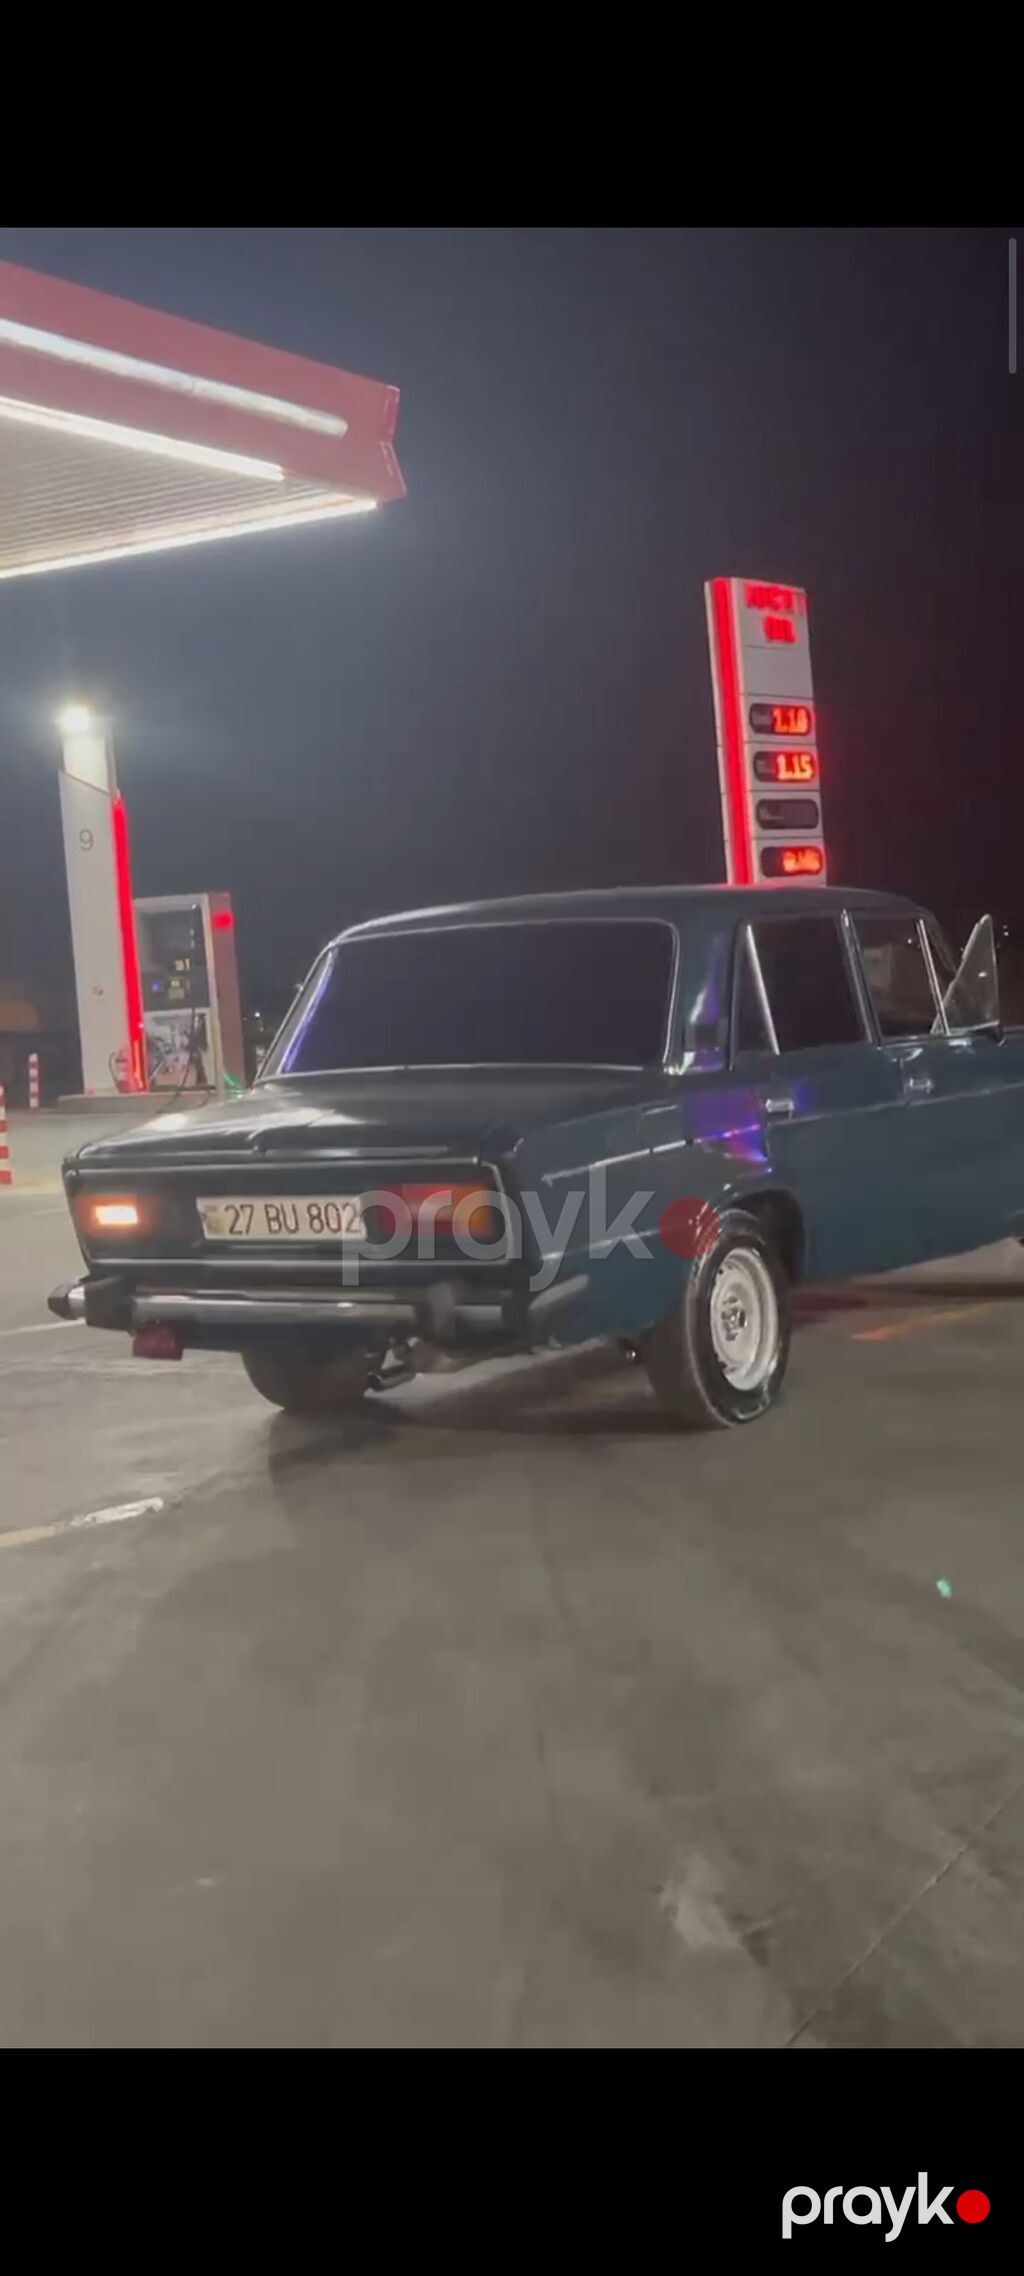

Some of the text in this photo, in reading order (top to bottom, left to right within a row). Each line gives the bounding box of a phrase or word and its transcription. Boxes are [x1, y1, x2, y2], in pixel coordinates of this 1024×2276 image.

[777, 753, 814, 780] 1.15
[79, 829, 94, 852] 9
[224, 1202, 361, 1235] 27 BU 802
